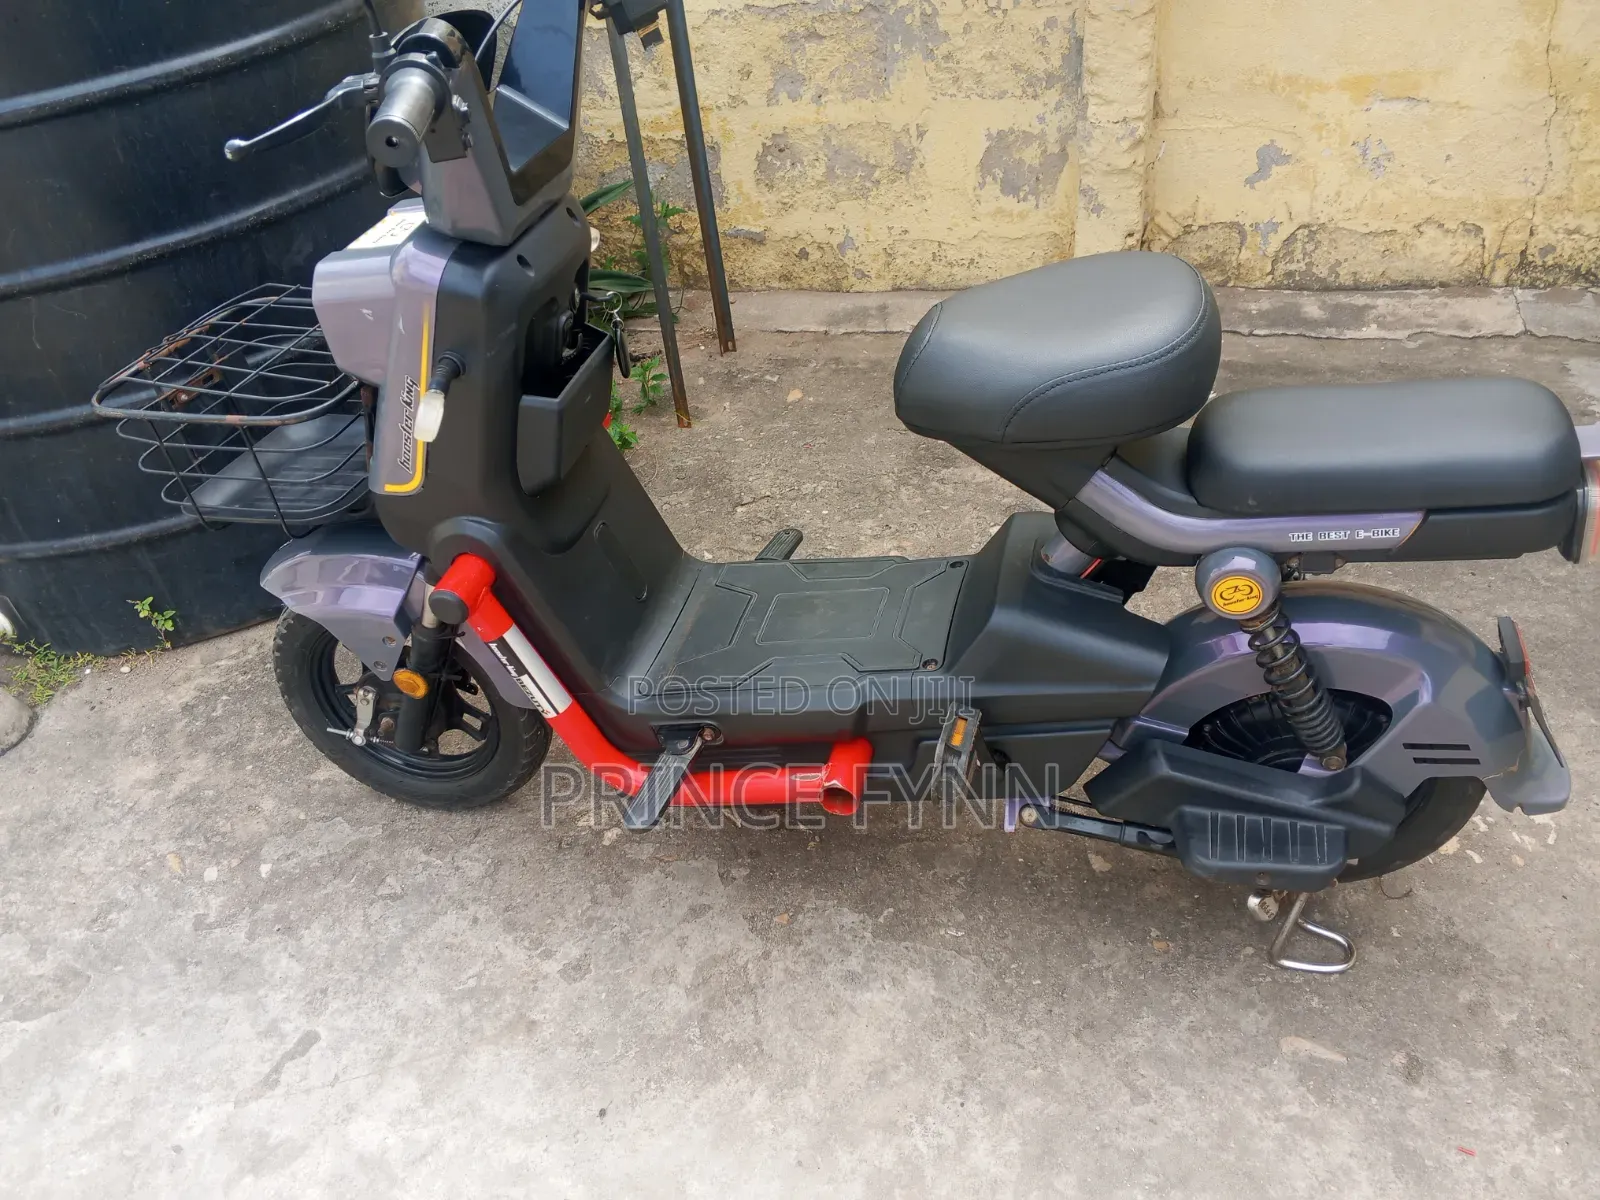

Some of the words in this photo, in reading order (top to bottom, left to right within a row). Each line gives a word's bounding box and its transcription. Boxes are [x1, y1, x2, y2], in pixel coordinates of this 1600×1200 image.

[1289, 532, 1313, 542] THE
[1318, 530, 1350, 541] BEST
[1355, 528, 1400, 539] E-BIKE
